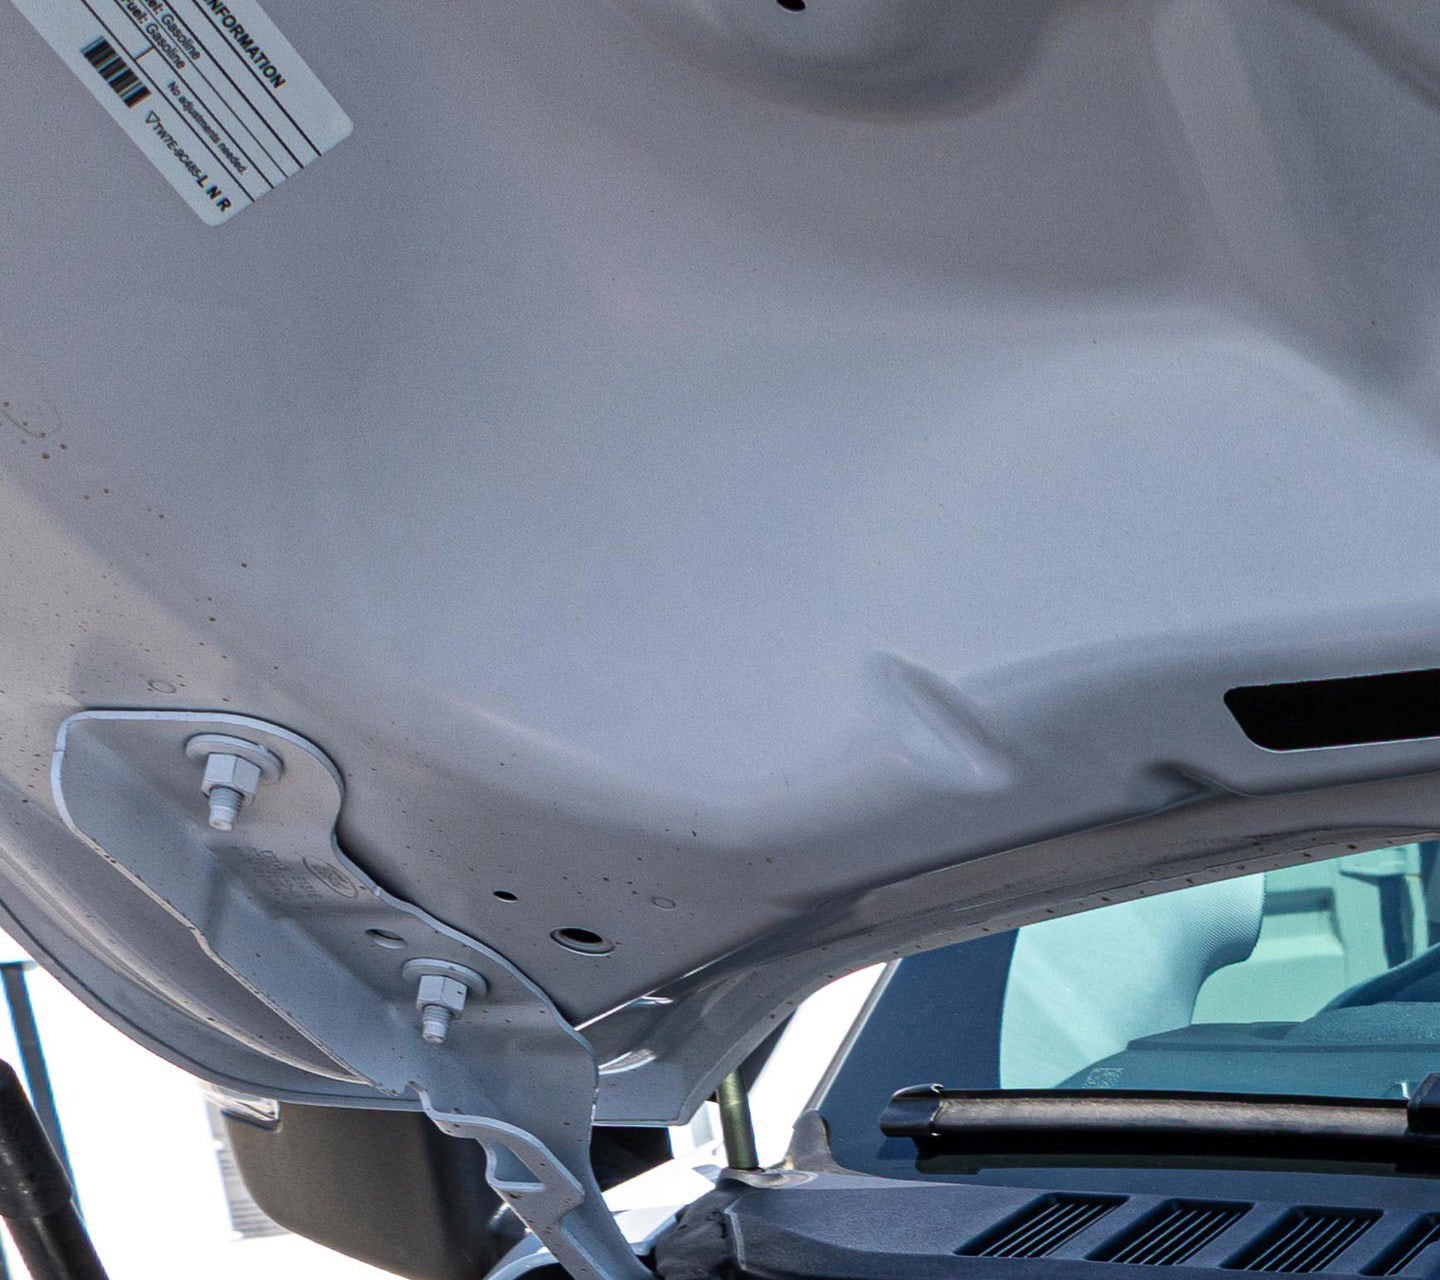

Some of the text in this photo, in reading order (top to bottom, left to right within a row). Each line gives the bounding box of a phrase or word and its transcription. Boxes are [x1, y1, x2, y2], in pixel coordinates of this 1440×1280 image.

[145, 23, 186, 70] Gasoline
[161, 13, 201, 61] Gasoline
[206, 0, 286, 89] NFORMATION
[167, 81, 180, 97] No
[178, 96, 221, 144] adjustments
